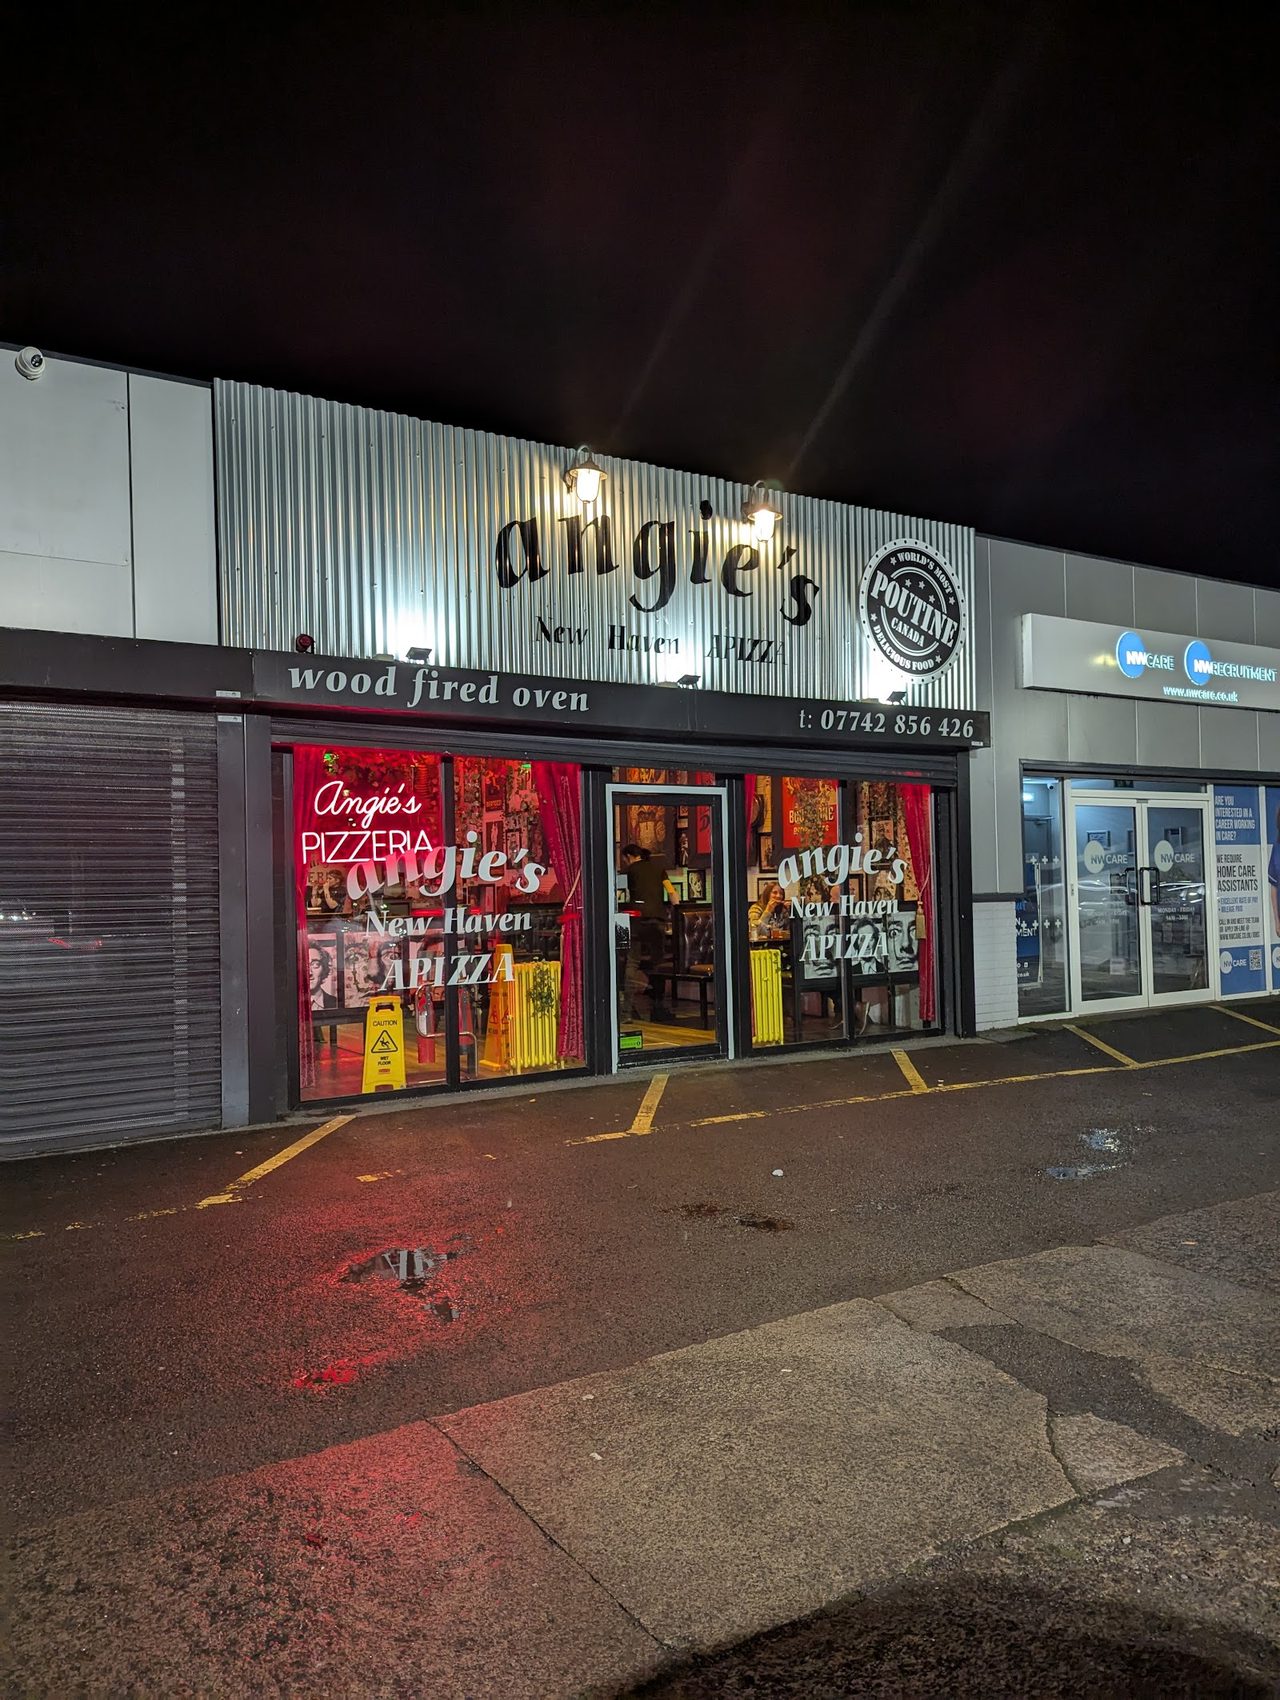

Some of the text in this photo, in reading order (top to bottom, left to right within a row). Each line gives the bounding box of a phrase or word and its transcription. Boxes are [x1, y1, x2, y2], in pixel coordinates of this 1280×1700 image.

[495, 500, 820, 626] angie's
[897, 551, 953, 594] WORLD'S MOST
[870, 570, 958, 648] POUTINE
[535, 615, 789, 666] New Haven APIZZA
[873, 624, 935, 671] DELICIOUS FOOD
[891, 616, 925, 647] CANADA
[288, 666, 590, 712] wood fired oven
[1162, 686, 1239, 703] www.nwcare.co.uk
[799, 709, 974, 738] t: 07742 856 426
[314, 780, 422, 829] Angie's
[301, 829, 433, 865] PIZZERIA
[346, 831, 546, 900] angie's
[777, 832, 909, 890] angie's
[1216, 865, 1256, 878] HOME CARE
[1217, 879, 1258, 892] ASSISTANTS
[365, 908, 532, 938] New Haven
[789, 894, 899, 920] New Haven
[800, 932, 888, 962] APIZZA
[379, 953, 515, 992] APIZZA
